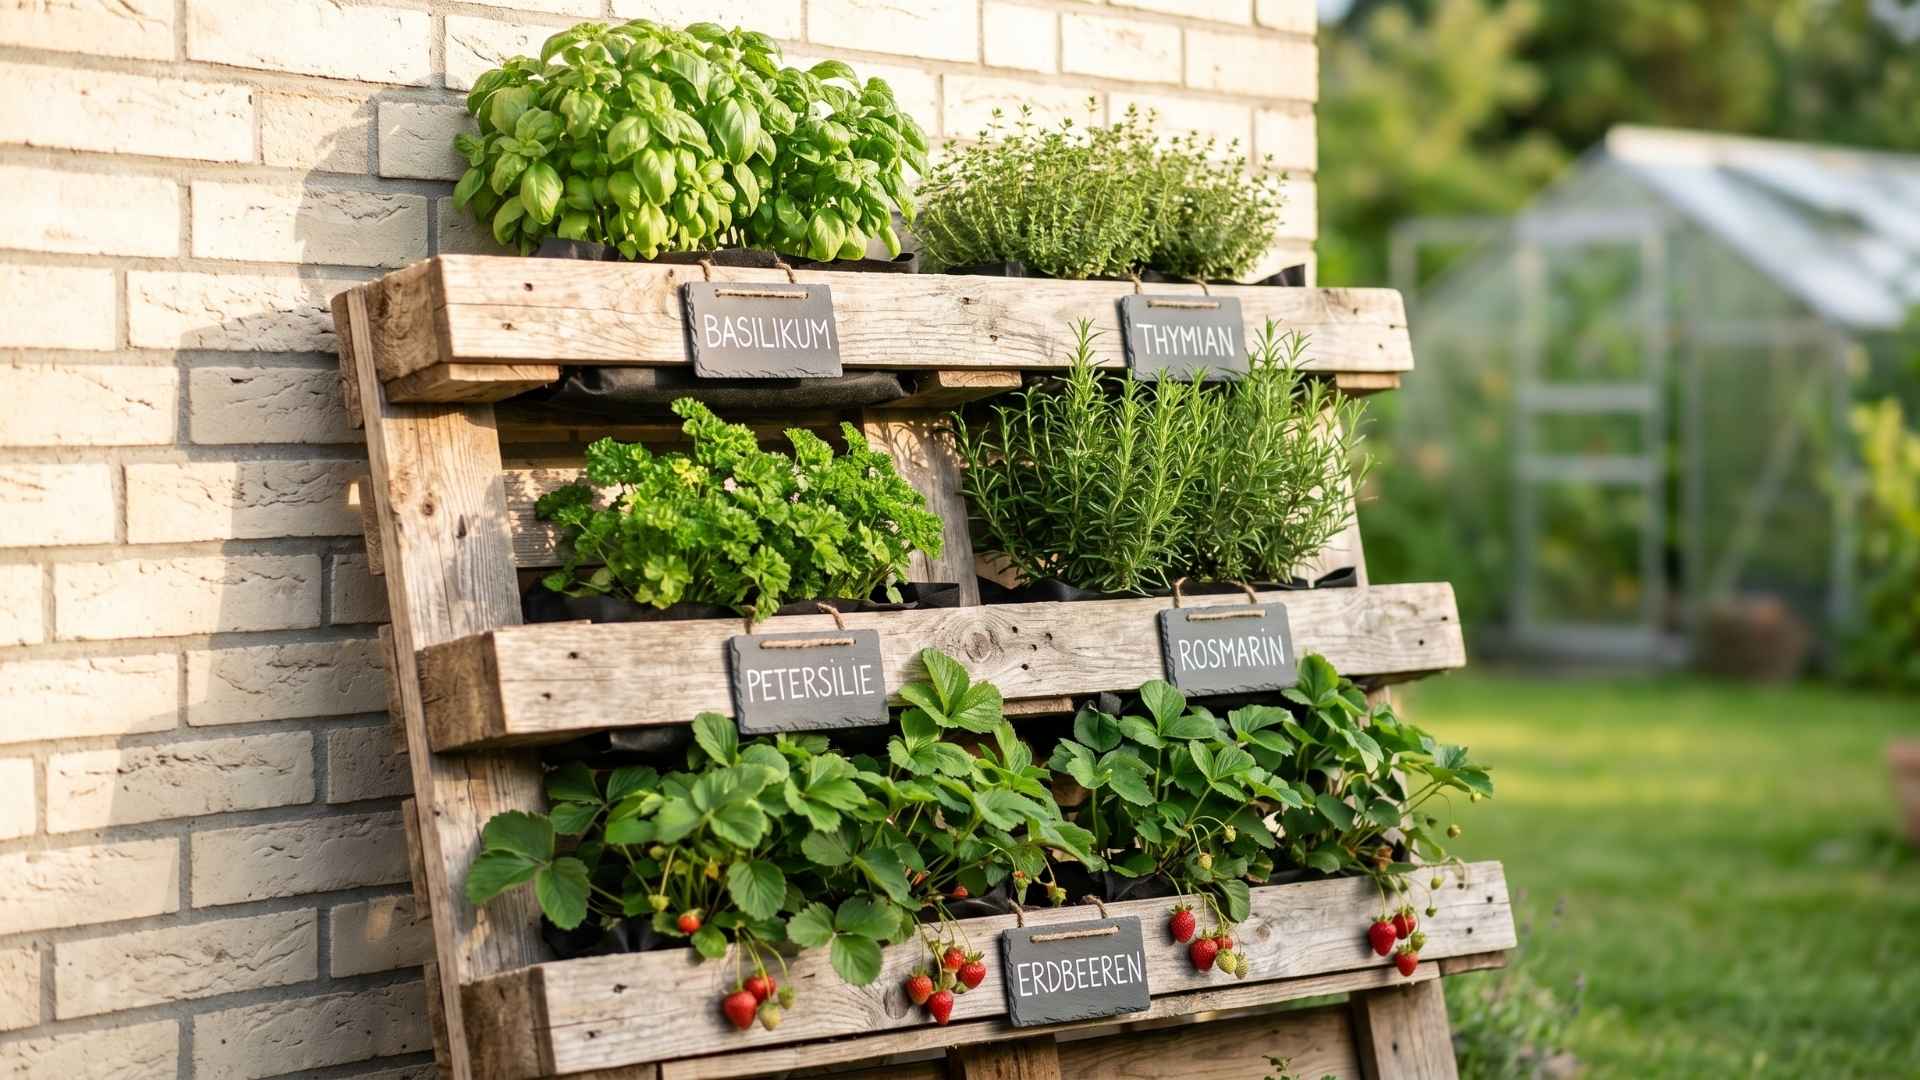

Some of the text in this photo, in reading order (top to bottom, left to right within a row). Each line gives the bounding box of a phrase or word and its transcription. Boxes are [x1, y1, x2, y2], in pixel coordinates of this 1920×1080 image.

[703, 313, 832, 350] BASILIKUM
[1136, 323, 1236, 357] THYMIAN
[1017, 951, 1143, 997] ERDBEEREN
